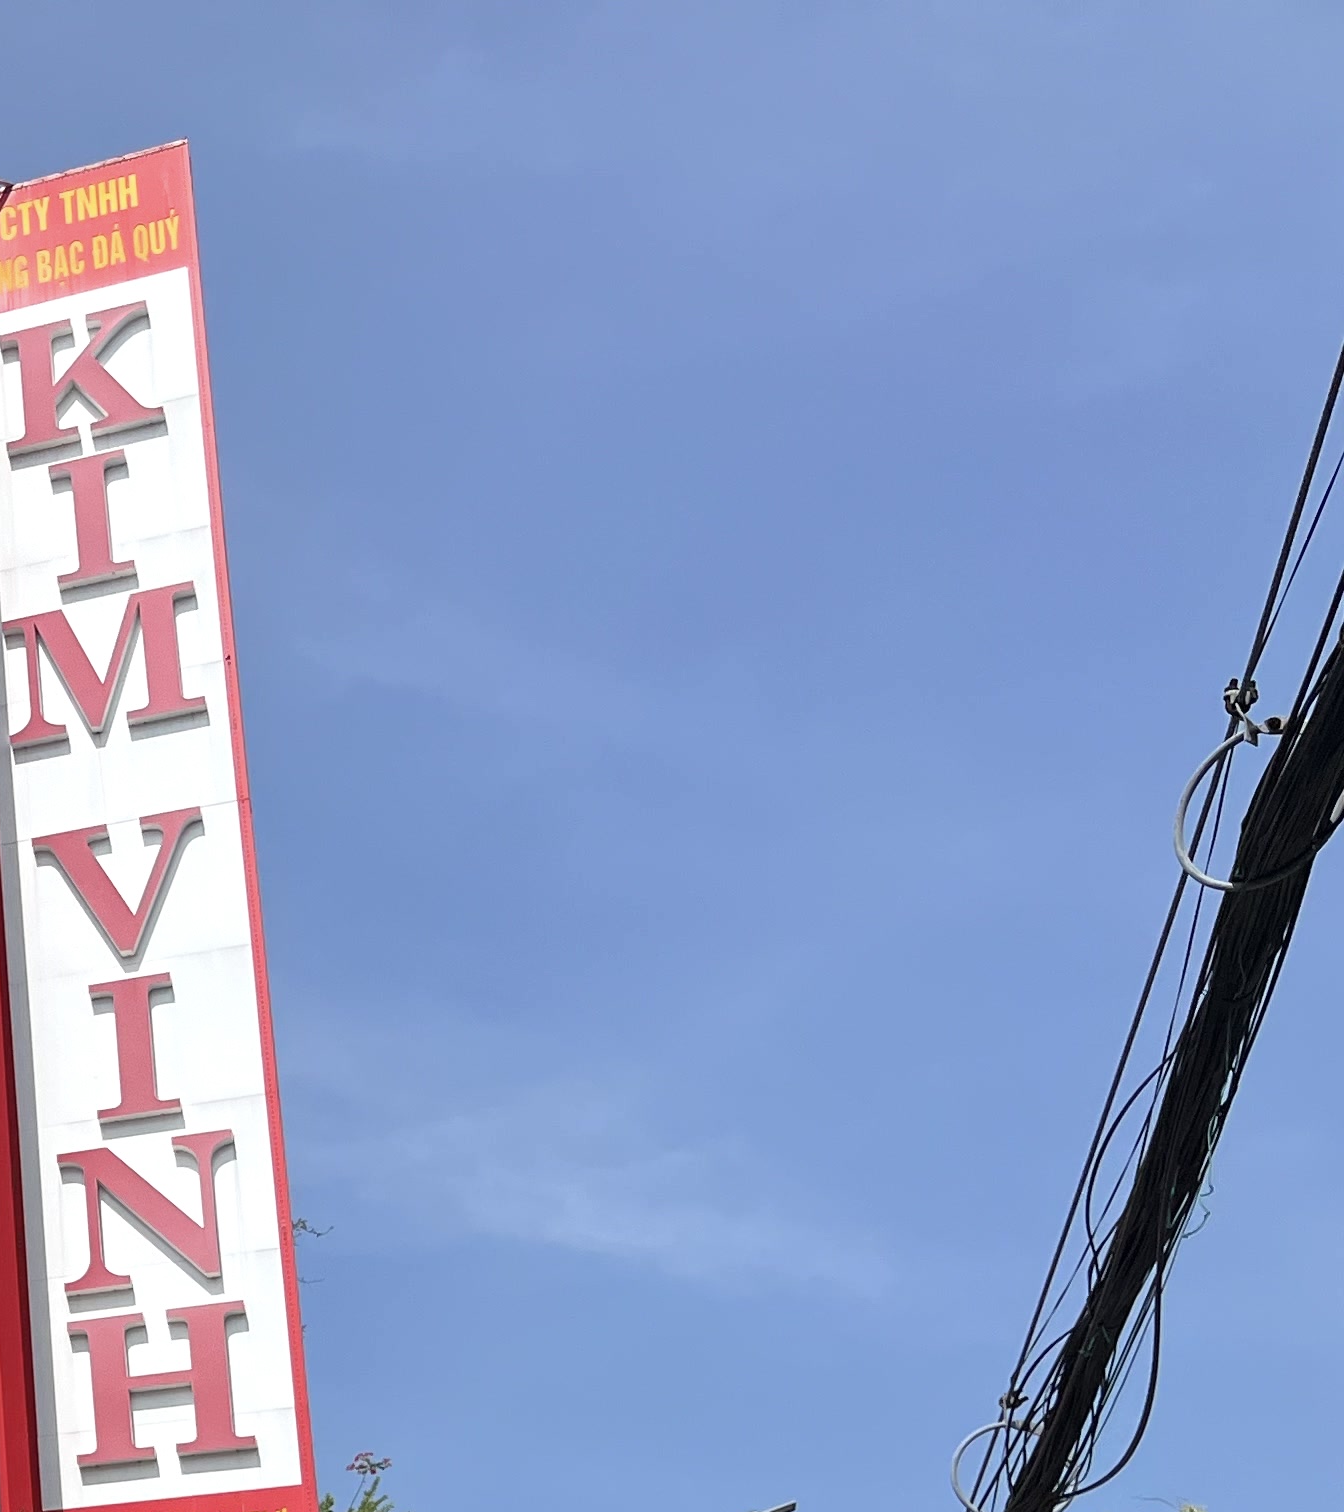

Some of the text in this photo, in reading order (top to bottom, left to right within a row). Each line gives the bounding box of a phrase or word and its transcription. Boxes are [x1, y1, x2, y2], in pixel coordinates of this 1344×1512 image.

[0, 173, 139, 241] CTY TNHH
[35, 239, 85, 289] BẠC
[92, 223, 127, 270] ĐÁ
[133, 208, 181, 263] QUÝ
[31, 806, 260, 1483] VINH
